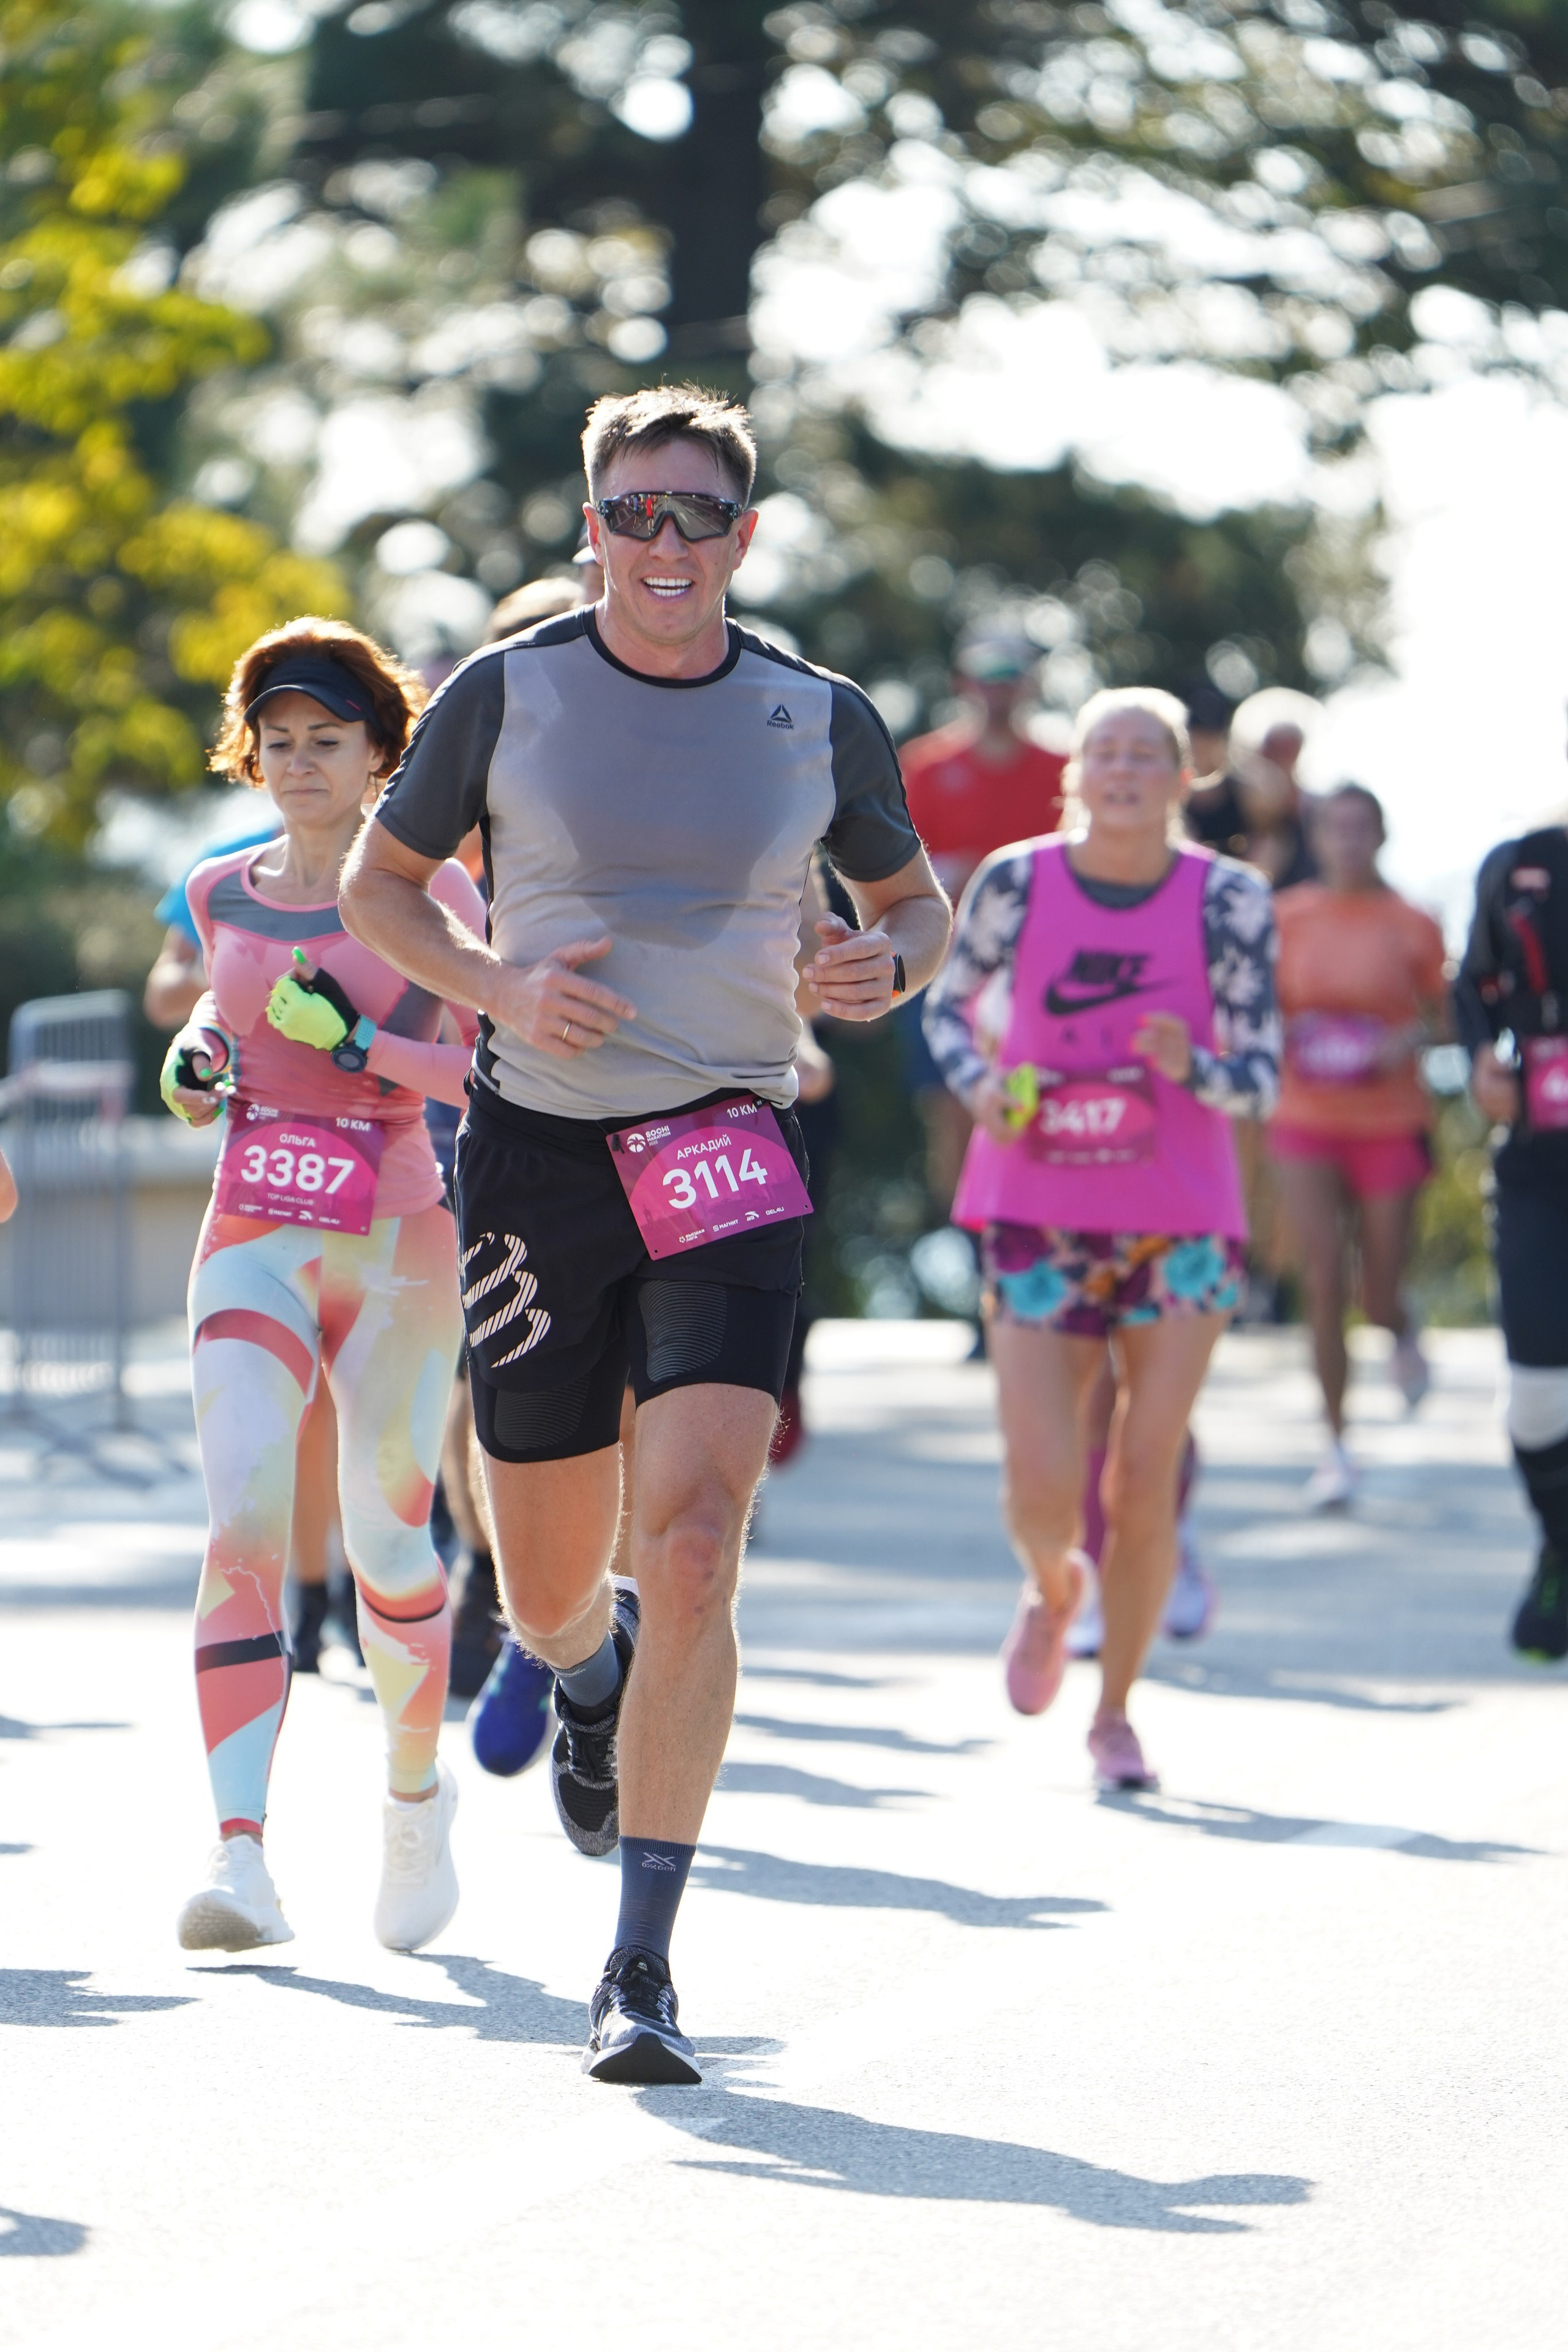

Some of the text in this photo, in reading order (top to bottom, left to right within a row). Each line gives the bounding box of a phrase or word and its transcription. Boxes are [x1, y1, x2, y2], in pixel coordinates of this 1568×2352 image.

[767, 720, 794, 729] Reebok
[727, 1103, 758, 1118] 10 KM
[1040, 1098, 1126, 1136] 3417
[336, 1117, 370, 1131] 10 KM
[646, 1125, 669, 1138] SOCHI
[647, 1131, 671, 1142] MARATHON
[279, 1133, 315, 1147] ОЛЬГА
[677, 1134, 731, 1160] АРКАДИЙ
[241, 1145, 355, 1194] 3387
[663, 1148, 767, 1209] 3114
[766, 1207, 785, 1216] GEL4U
[719, 1219, 739, 1229] МАГНИТ
